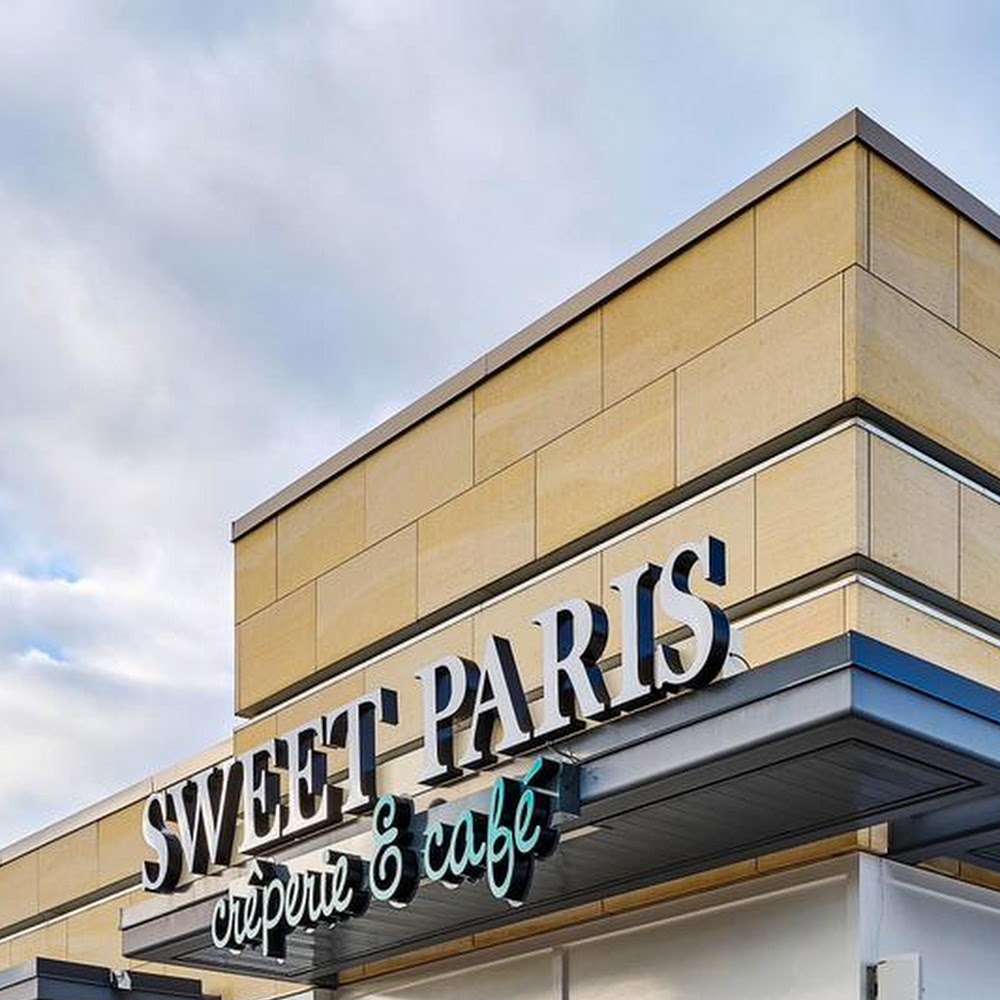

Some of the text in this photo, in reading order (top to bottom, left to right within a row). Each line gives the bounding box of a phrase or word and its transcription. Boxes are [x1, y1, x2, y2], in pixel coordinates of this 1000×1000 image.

[142, 535, 729, 893] SWEET PARIS
[211, 849, 355, 957] crêperie
[424, 756, 542, 899] café
